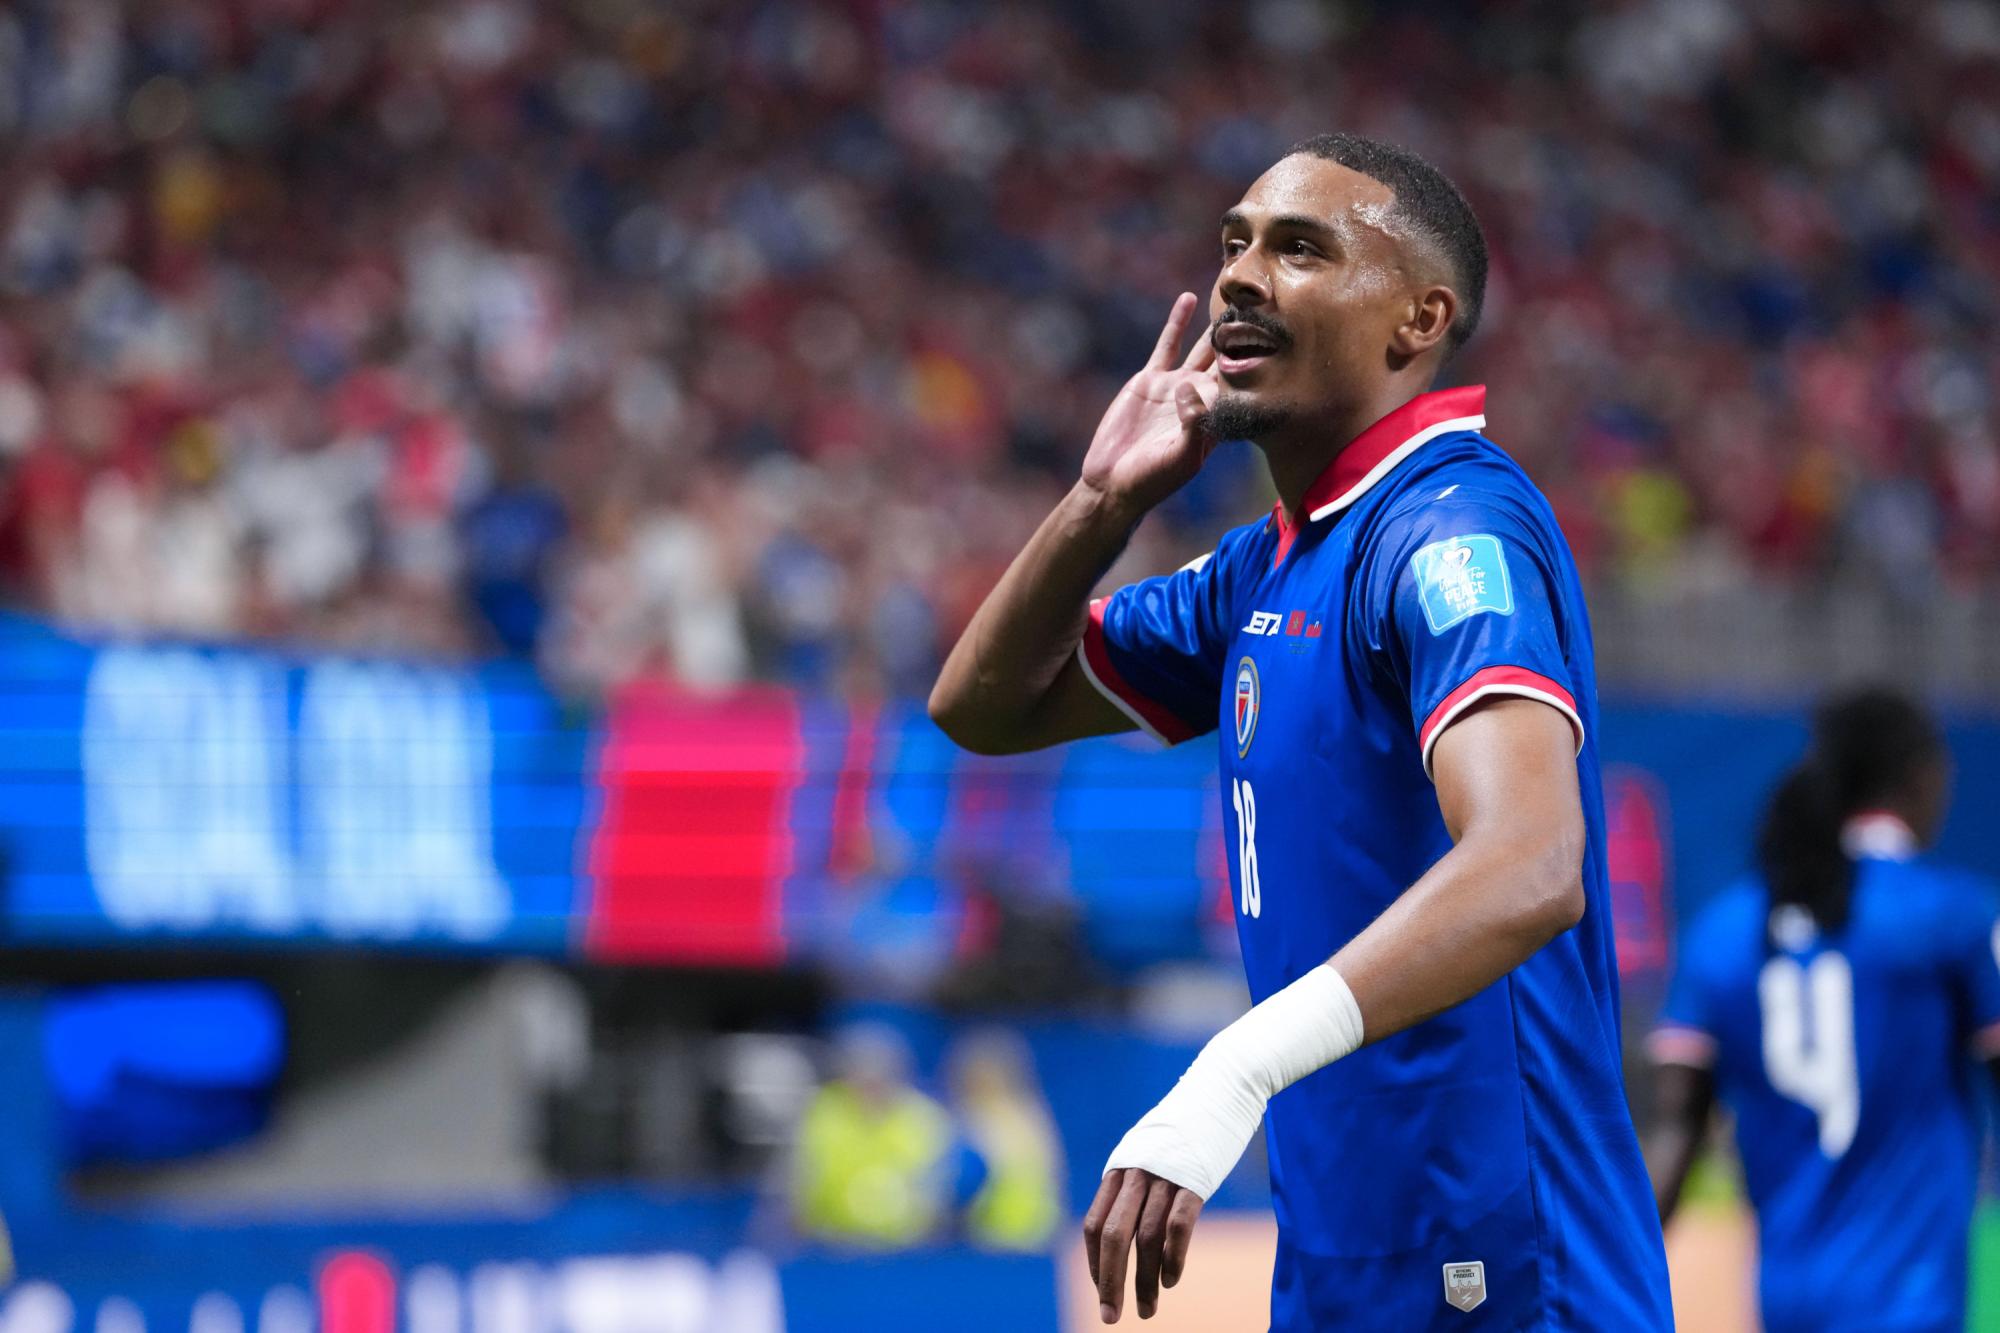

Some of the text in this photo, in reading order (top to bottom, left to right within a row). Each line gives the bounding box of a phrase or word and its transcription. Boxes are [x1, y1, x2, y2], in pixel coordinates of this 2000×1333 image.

[1444, 580, 1487, 606] PEACE
[1233, 777, 1261, 919] 18
[1757, 950, 1861, 1161] 4
